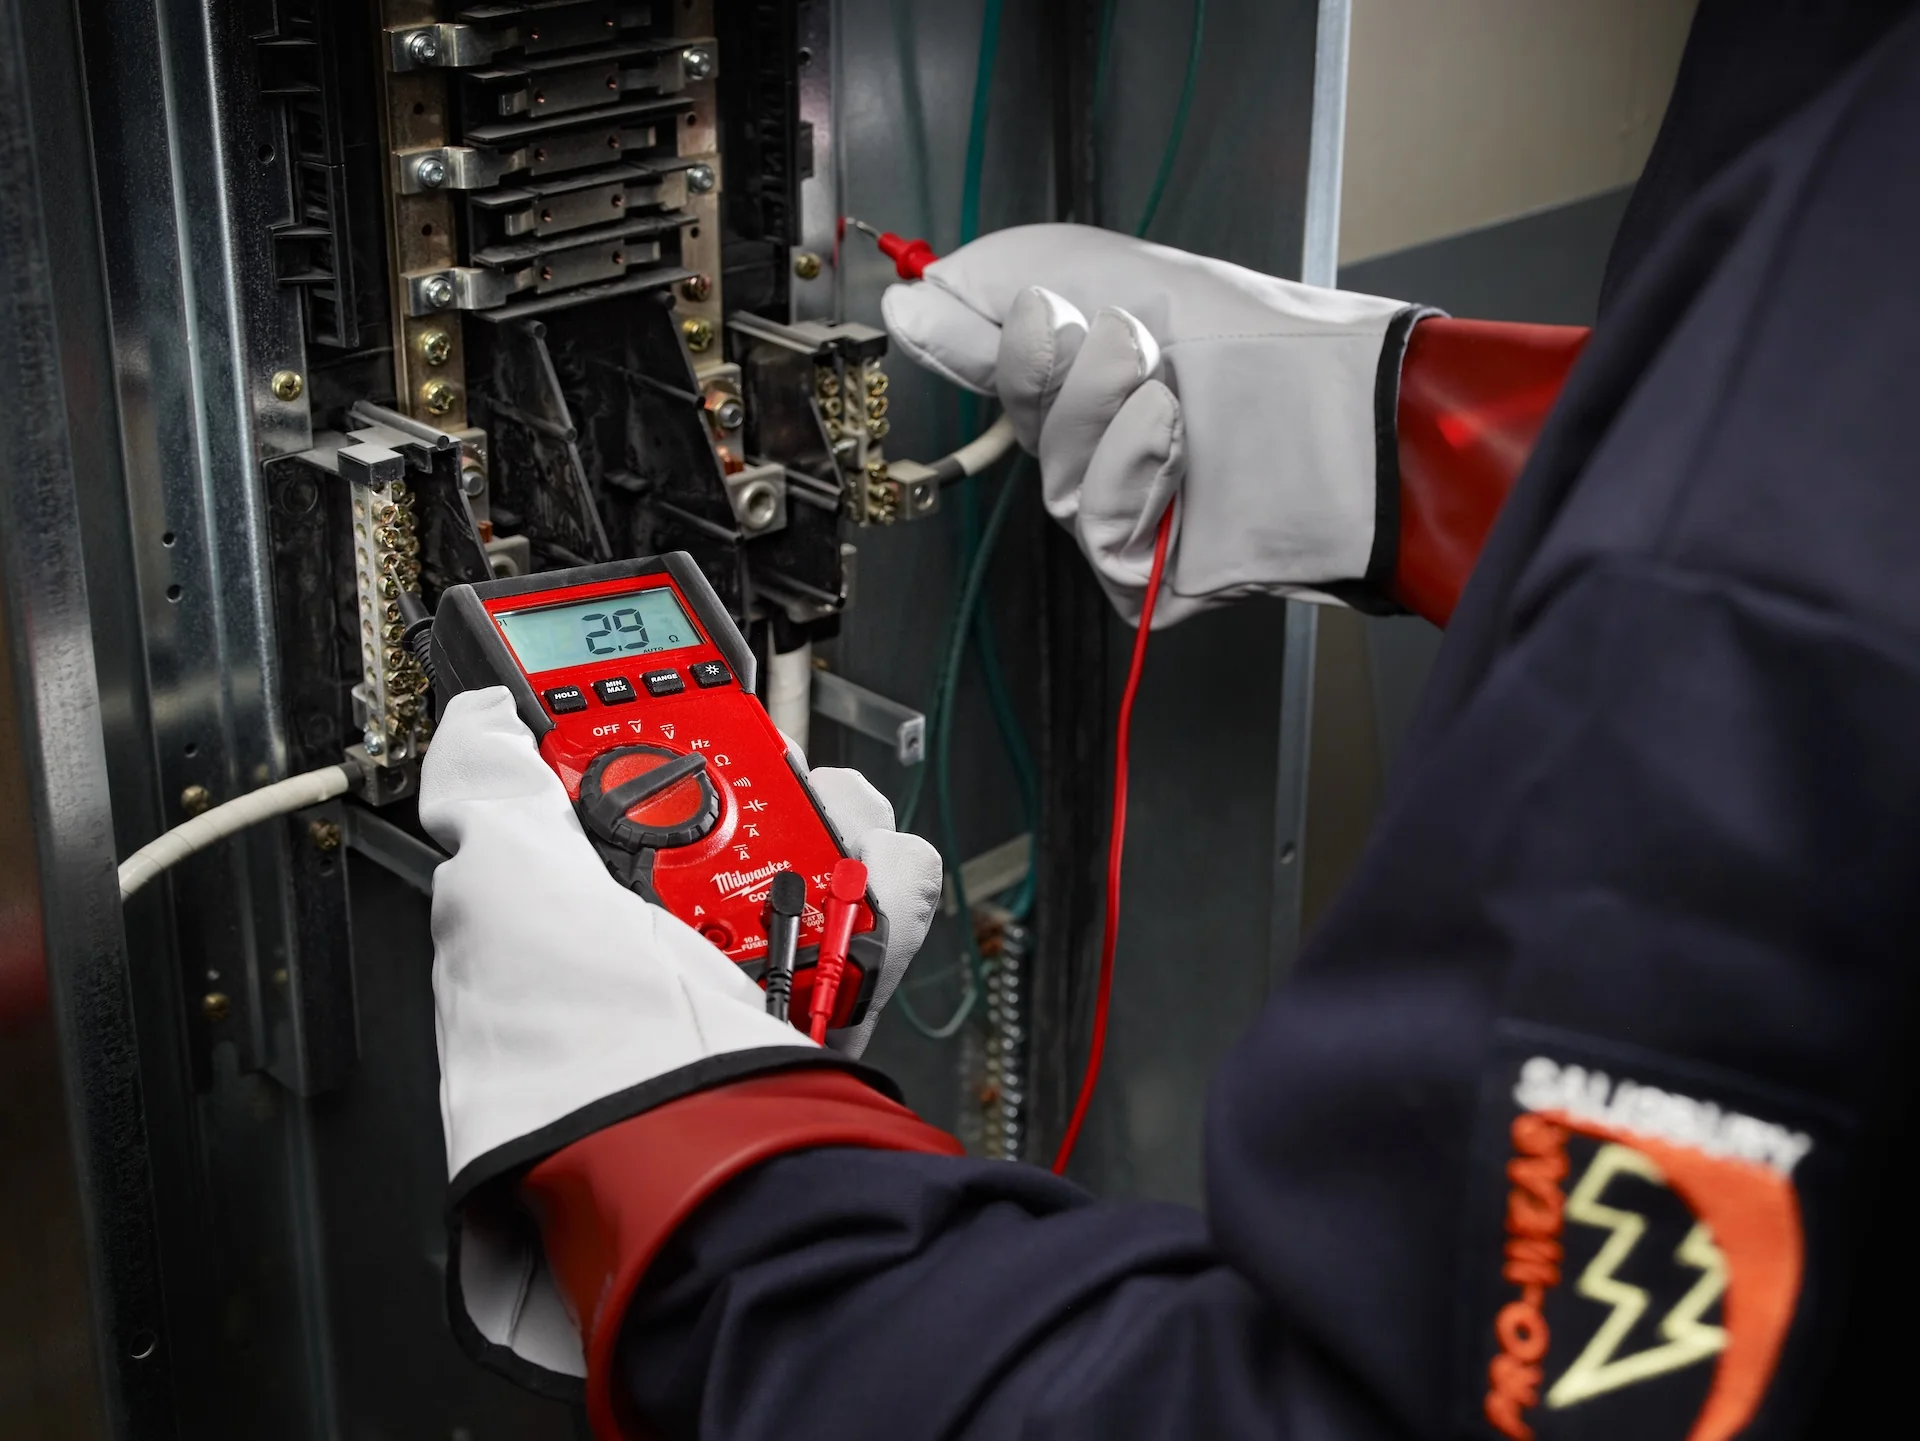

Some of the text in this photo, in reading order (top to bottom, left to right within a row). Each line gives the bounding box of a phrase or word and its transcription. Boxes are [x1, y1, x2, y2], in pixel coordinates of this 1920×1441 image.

[643, 646, 664, 654] AUTO
[651, 673, 678, 683] RANGE
[605, 679, 622, 688] MIN
[606, 684, 627, 693] MAX
[554, 690, 578, 700] HOLD
[592, 723, 620, 737] OFF
[691, 739, 710, 750] Hz
[709, 860, 792, 894] Milwaukee
[694, 905, 705, 916] A
[741, 939, 768, 951] FUSED
